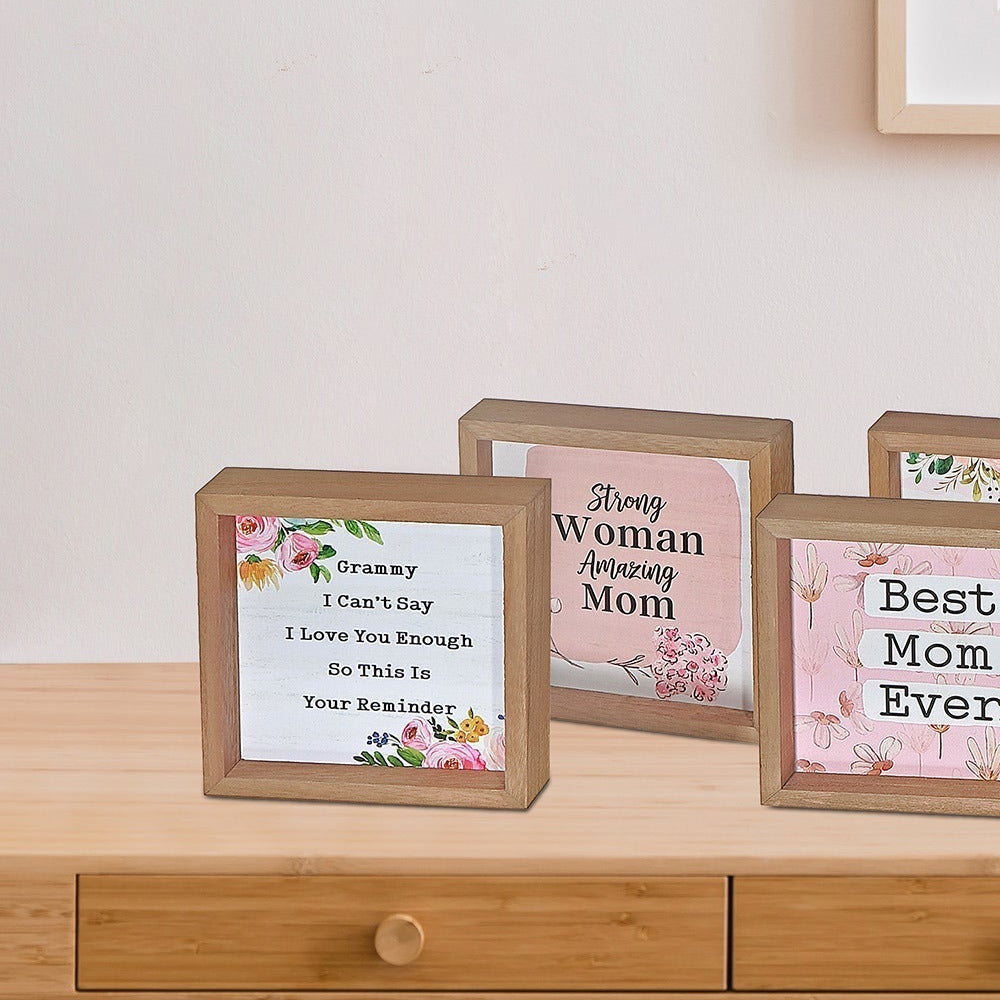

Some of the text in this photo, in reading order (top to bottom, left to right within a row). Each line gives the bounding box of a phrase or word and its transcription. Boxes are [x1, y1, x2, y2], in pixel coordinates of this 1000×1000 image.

[587, 483, 667, 523] Strong
[552, 513, 704, 556] Woman
[337, 560, 418, 579] Grammy
[577, 549, 679, 591] Amazing
[323, 594, 434, 614] I Can't Say
[581, 583, 676, 620] Mom
[879, 579, 996, 617] Best
[285, 626, 474, 650] I Love You Enough
[883, 633, 993, 670] Mom
[328, 663, 431, 680] So This Is
[303, 695, 457, 715] Your Reminder
